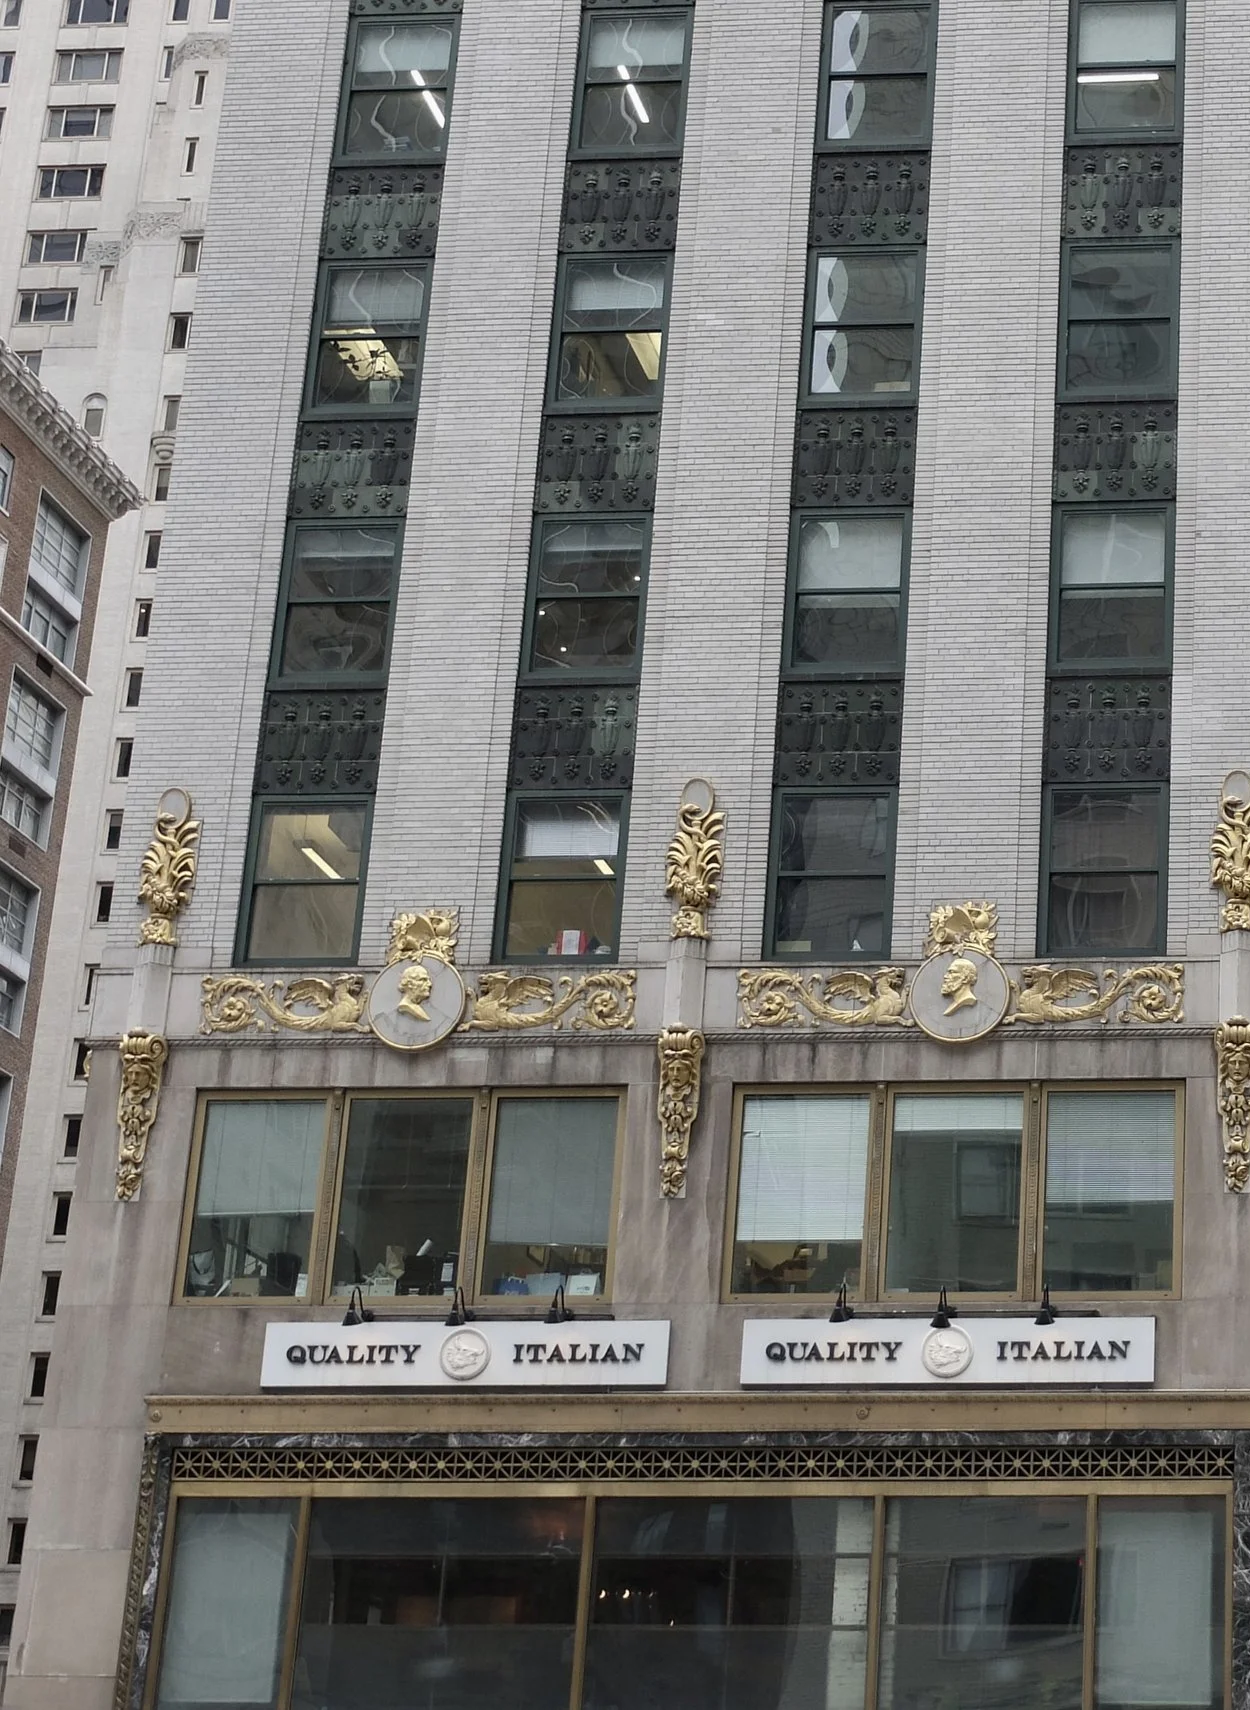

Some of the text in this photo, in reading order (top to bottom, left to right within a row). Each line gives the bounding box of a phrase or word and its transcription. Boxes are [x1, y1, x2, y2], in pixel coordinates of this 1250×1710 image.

[286, 1343, 645, 1366] QUALITY ITALIAN
[765, 1340, 1131, 1363] QUALITY ITALIAN
